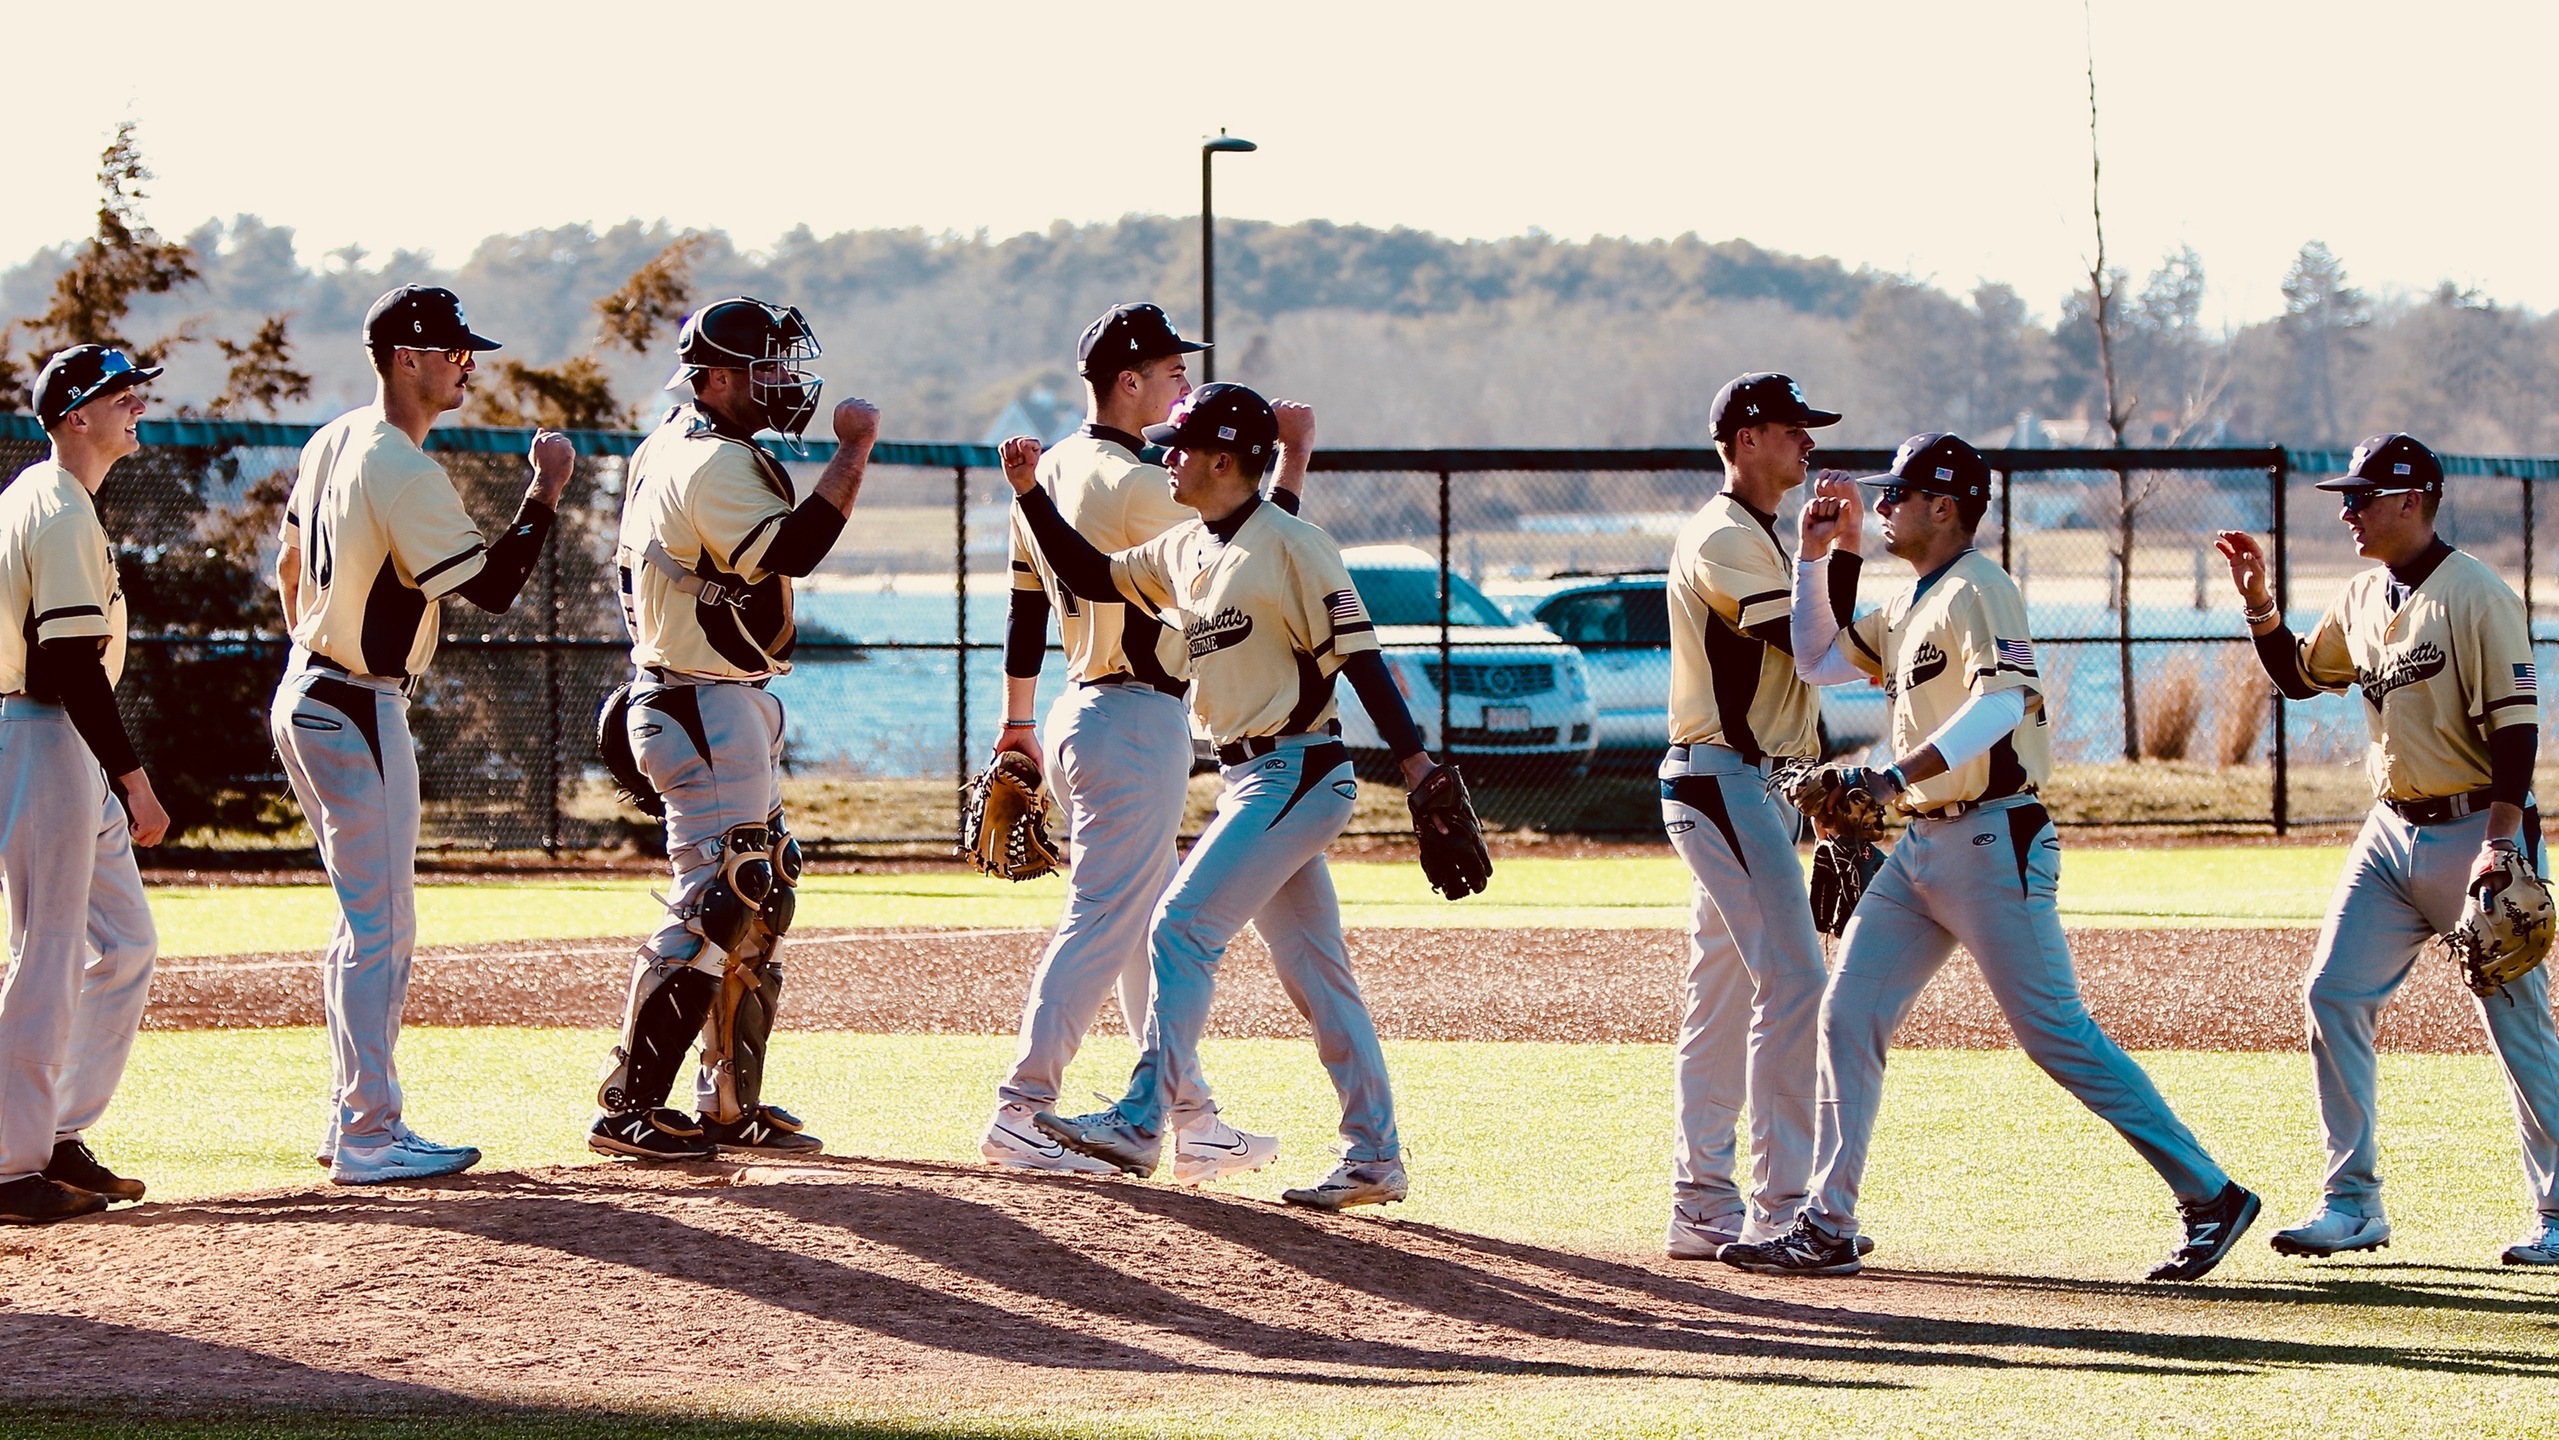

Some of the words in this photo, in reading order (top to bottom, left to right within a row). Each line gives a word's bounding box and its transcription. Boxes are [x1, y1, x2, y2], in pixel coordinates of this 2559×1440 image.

[413, 320, 422, 333] 6
[1130, 338, 1139, 350] 4
[67, 386, 82, 399] 29
[1746, 404, 1760, 416] 34
